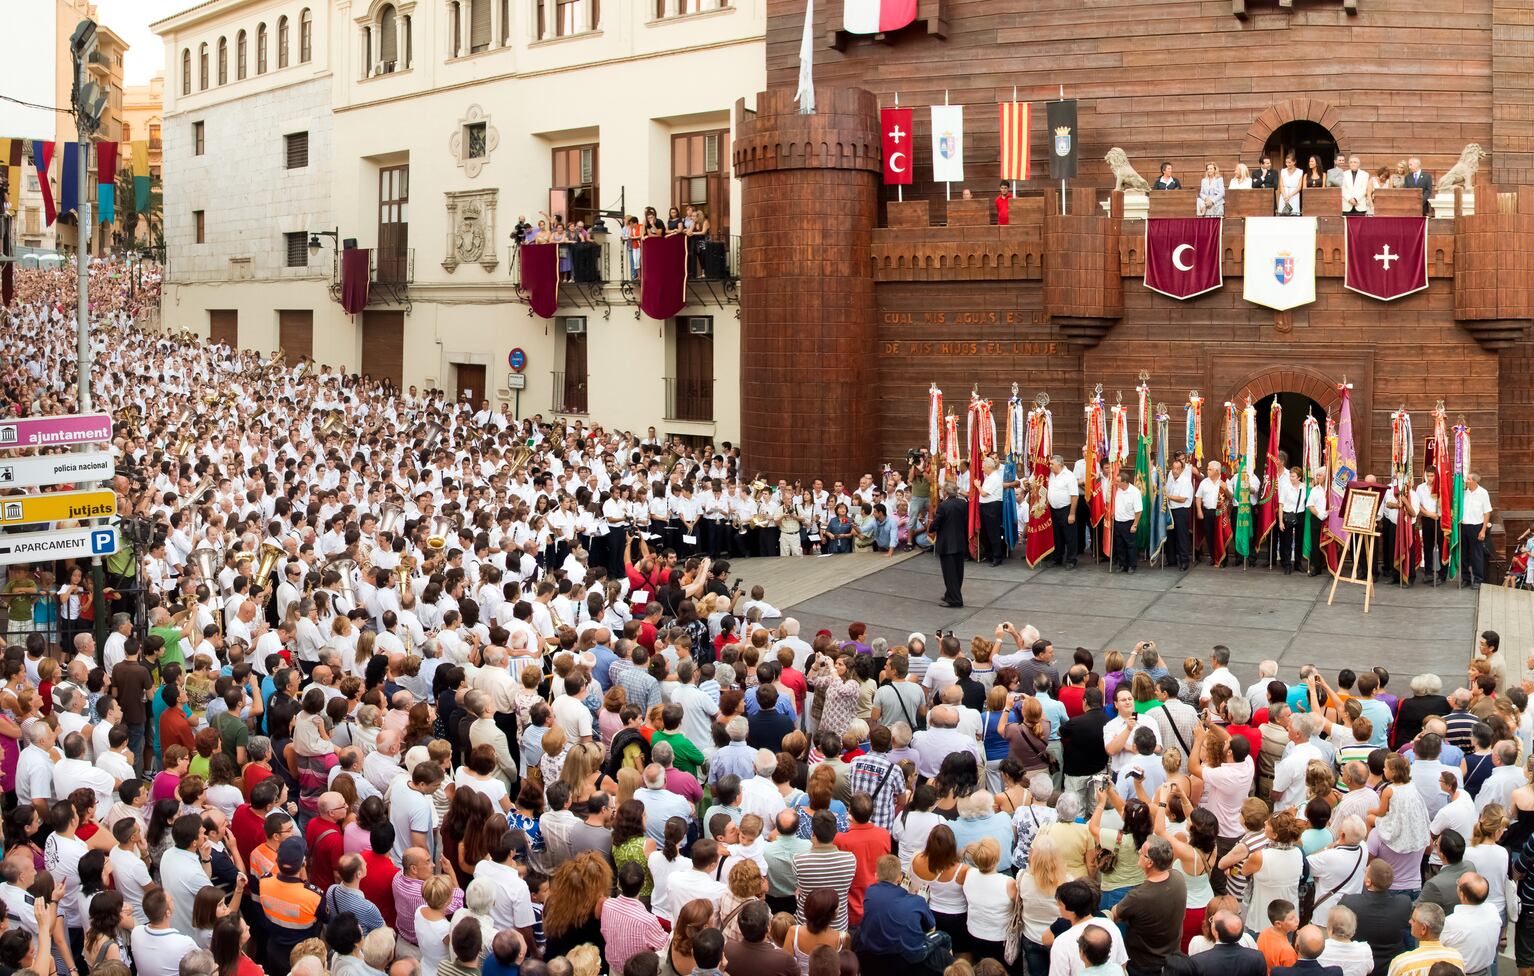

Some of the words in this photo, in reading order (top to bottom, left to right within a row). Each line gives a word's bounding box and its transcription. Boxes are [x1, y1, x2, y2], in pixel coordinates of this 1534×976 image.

[29, 428, 108, 444] ajuntament
[54, 464, 77, 474] policia
[79, 461, 108, 470] nacional
[69, 504, 113, 518] jutjats
[14, 538, 86, 553] APARCAMENT
[96, 533, 111, 551] P
